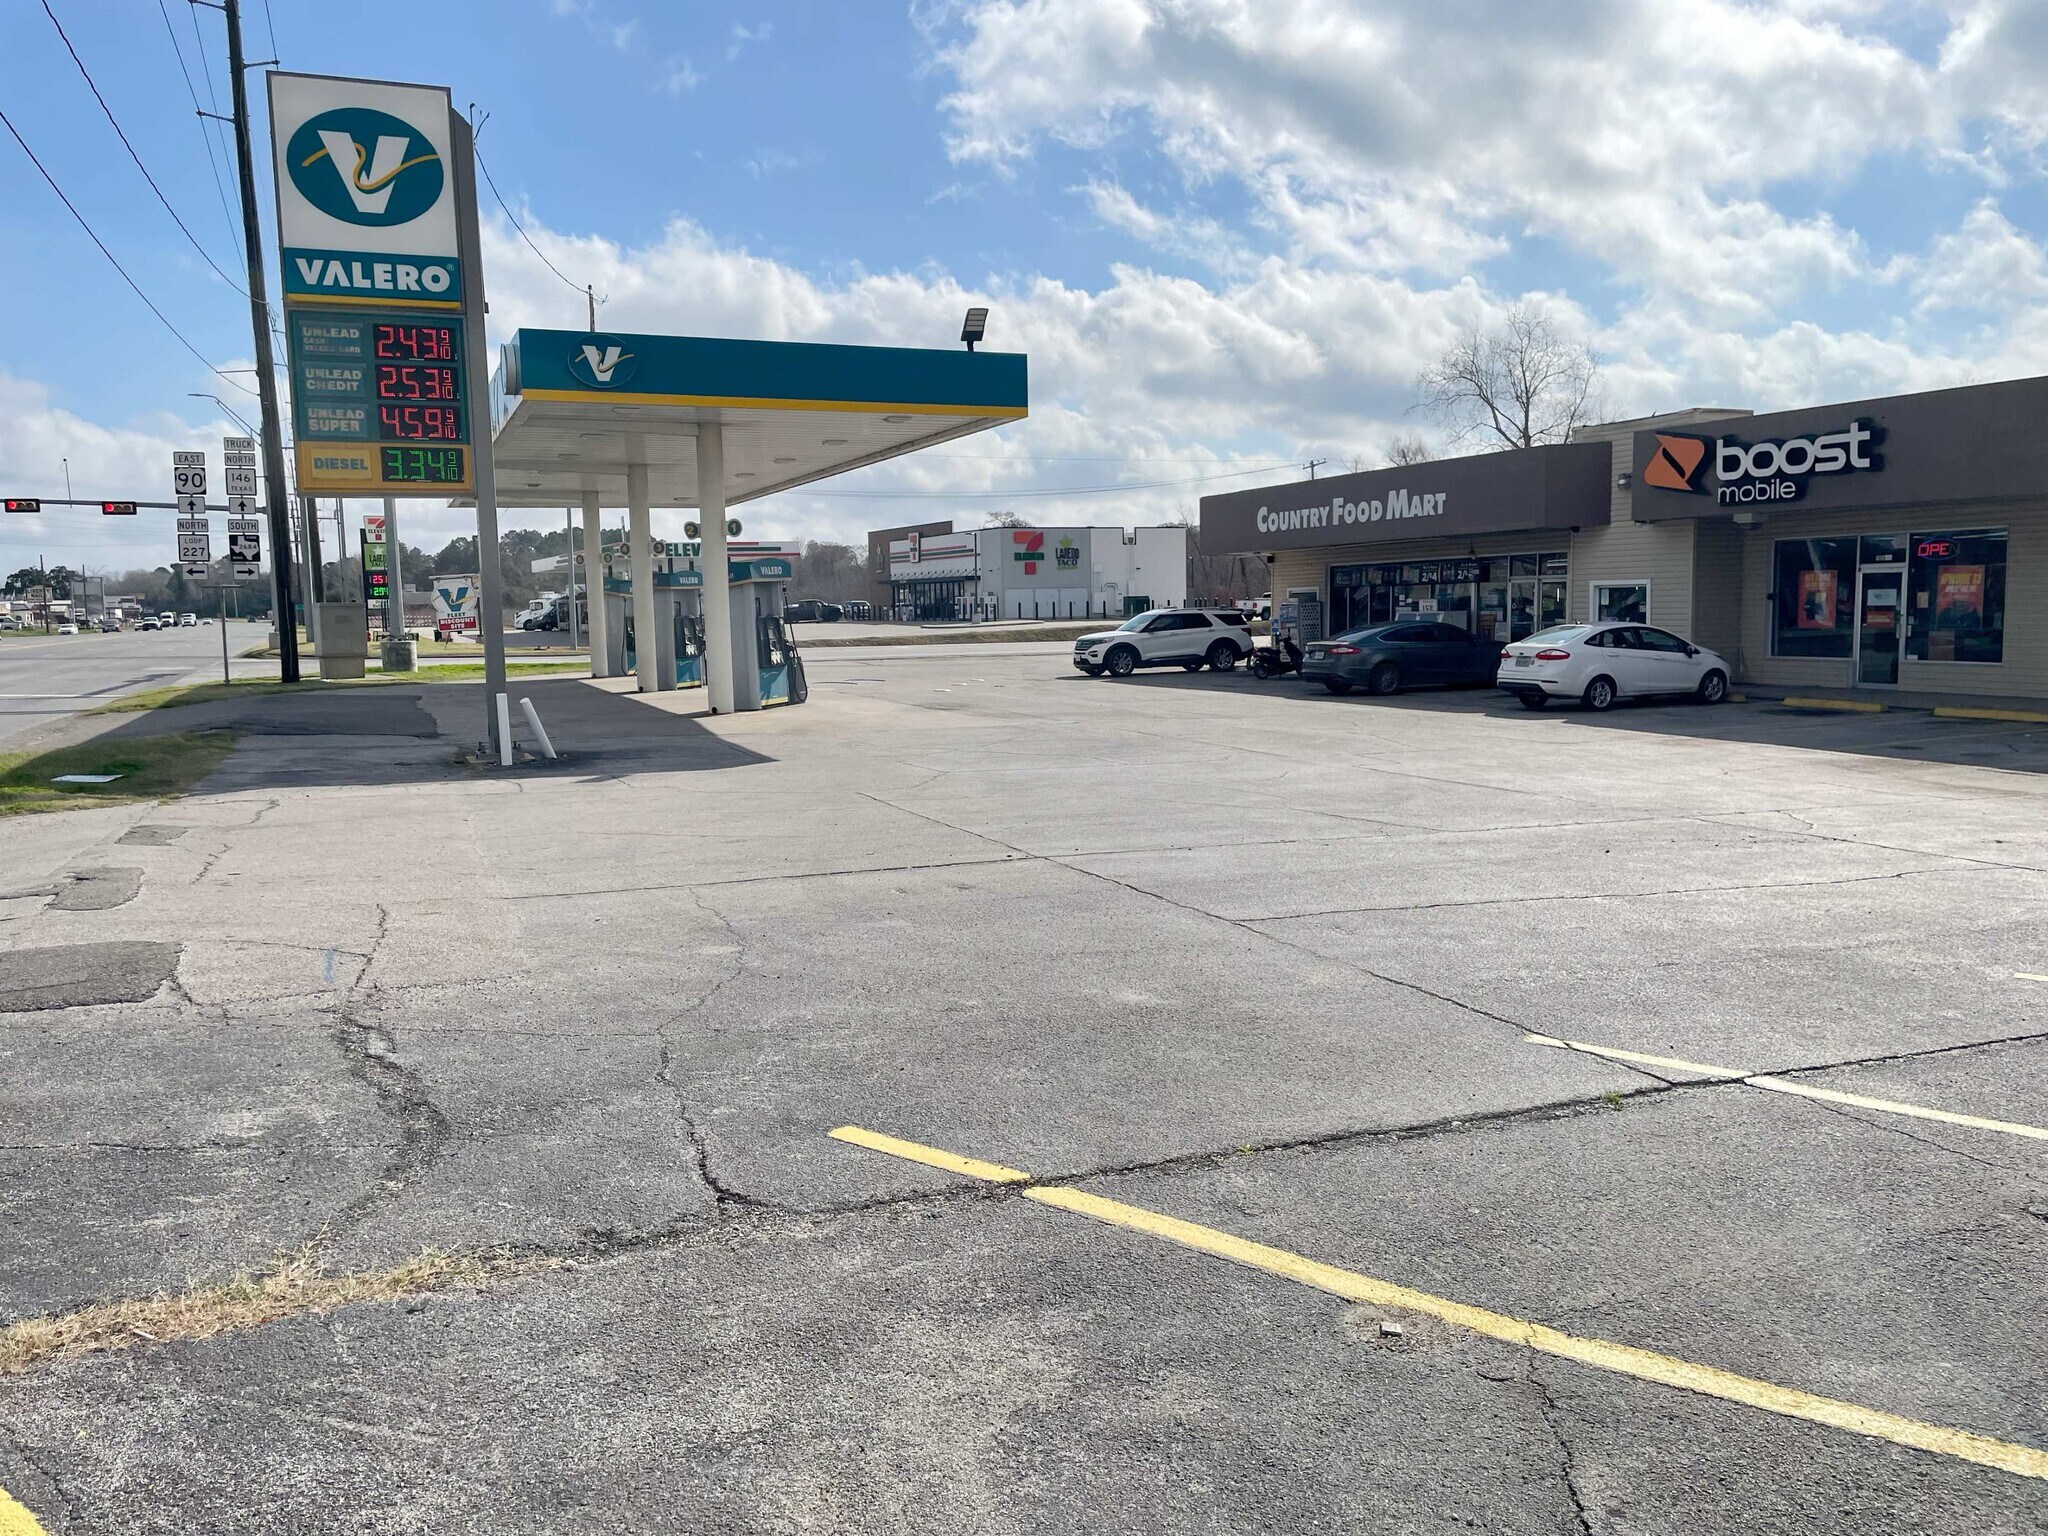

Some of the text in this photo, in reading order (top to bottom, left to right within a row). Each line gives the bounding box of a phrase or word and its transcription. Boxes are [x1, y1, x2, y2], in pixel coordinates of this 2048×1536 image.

[295, 258, 450, 293] VALERO
[302, 327, 360, 339] UNLEAD
[305, 368, 362, 380] UNLEAD
[306, 379, 359, 391] CREDIT
[308, 408, 365, 420] UNLEAD
[308, 419, 360, 432] SUPER
[226, 440, 252, 448] TRUCK
[1715, 422, 1871, 482] boost
[178, 454, 200, 463] EAST
[226, 455, 253, 464] NORTH
[313, 457, 368, 471] DIESEL
[178, 472, 203, 488] 90
[231, 473, 251, 482] 146
[1717, 478, 1797, 503] mobile
[180, 521, 207, 530] NORTH
[230, 521, 257, 530] SOUTH
[1013, 531, 1044, 552] 7
[183, 547, 205, 557] 227
[665, 542, 700, 557] ELEV
[1055, 547, 1080, 559] LAREDO
[369, 554, 386, 562] LARED
[760, 566, 783, 575] VALERO
[679, 576, 699, 584] VALERO
[440, 617, 474, 625] DISCOUNT
